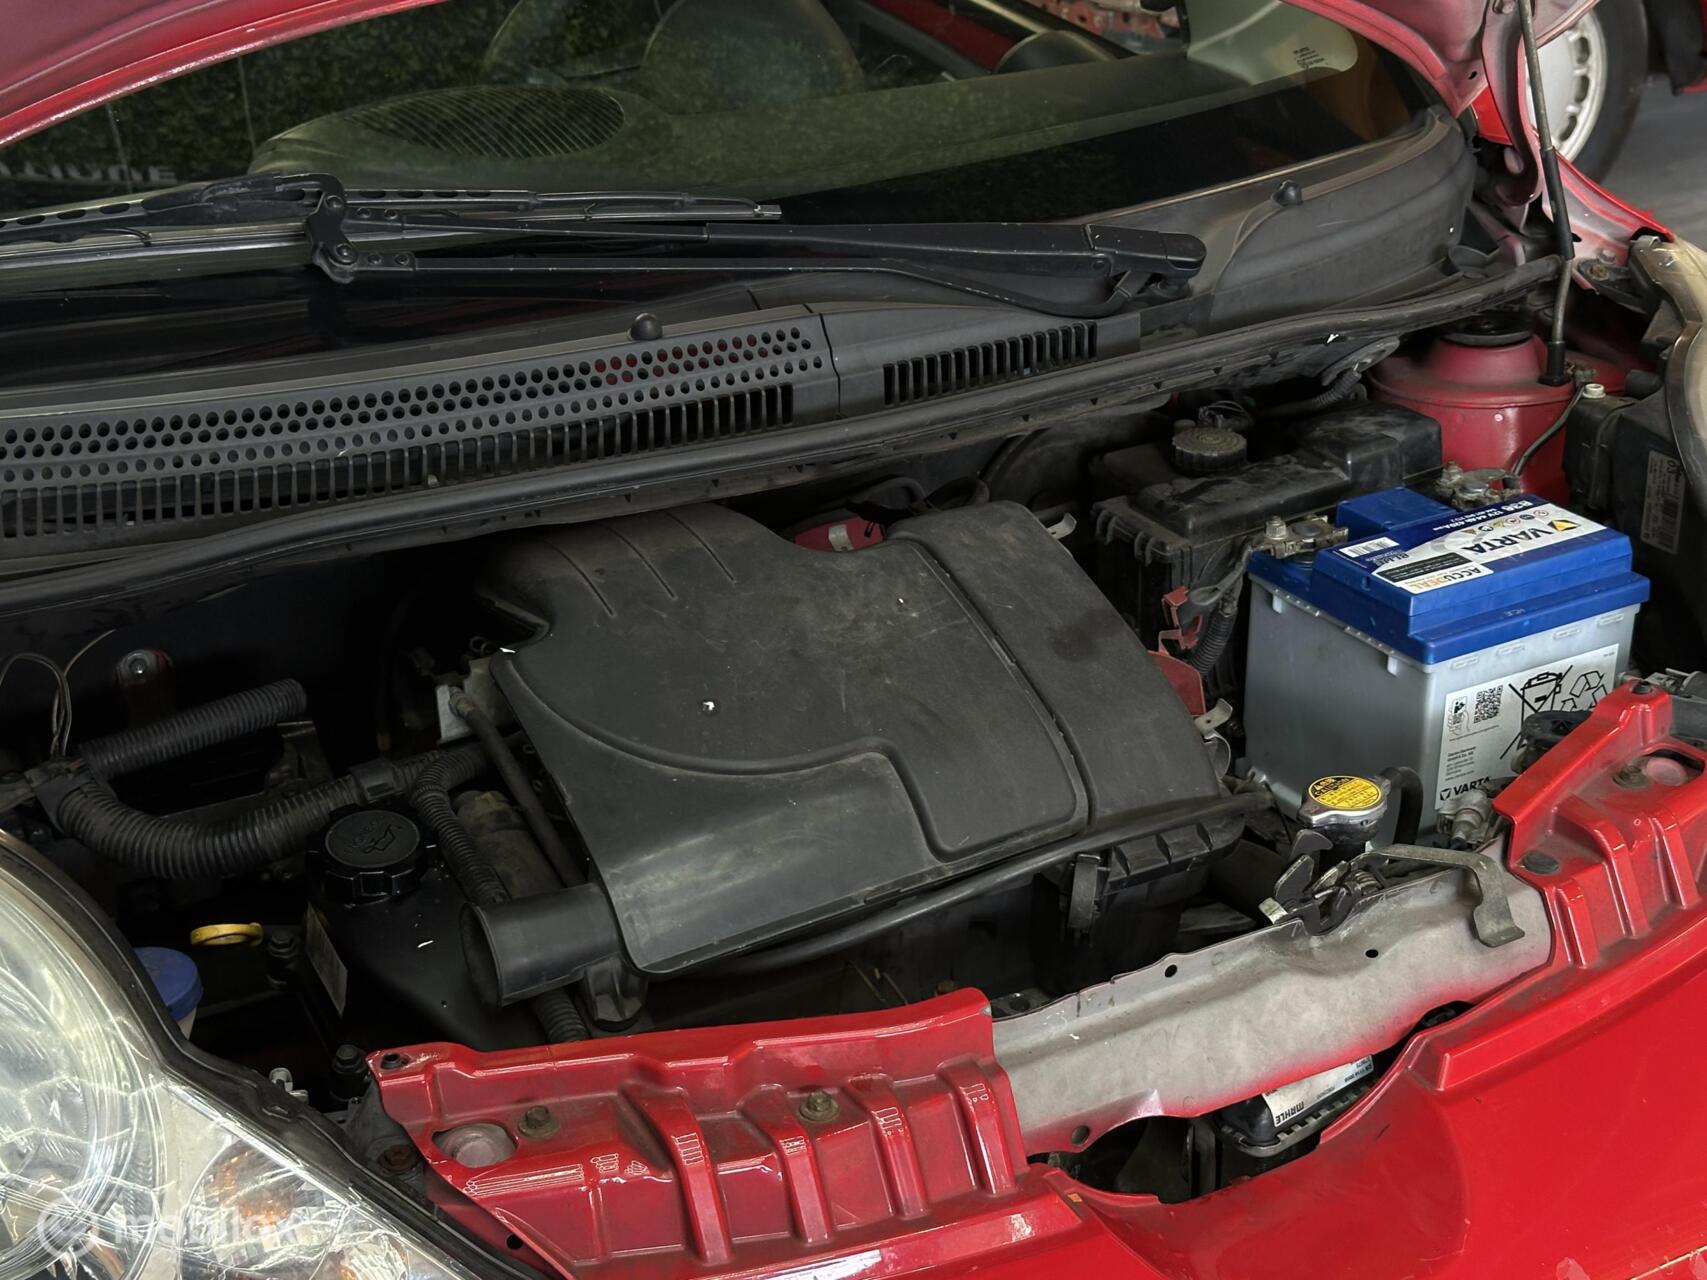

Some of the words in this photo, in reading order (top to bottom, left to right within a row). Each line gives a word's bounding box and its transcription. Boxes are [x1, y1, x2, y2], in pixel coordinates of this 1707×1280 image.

[1461, 527, 1554, 554] VARTA
[1408, 567, 1482, 588] ACCUDEAL
[1275, 1101, 1305, 1125] MAHLE
